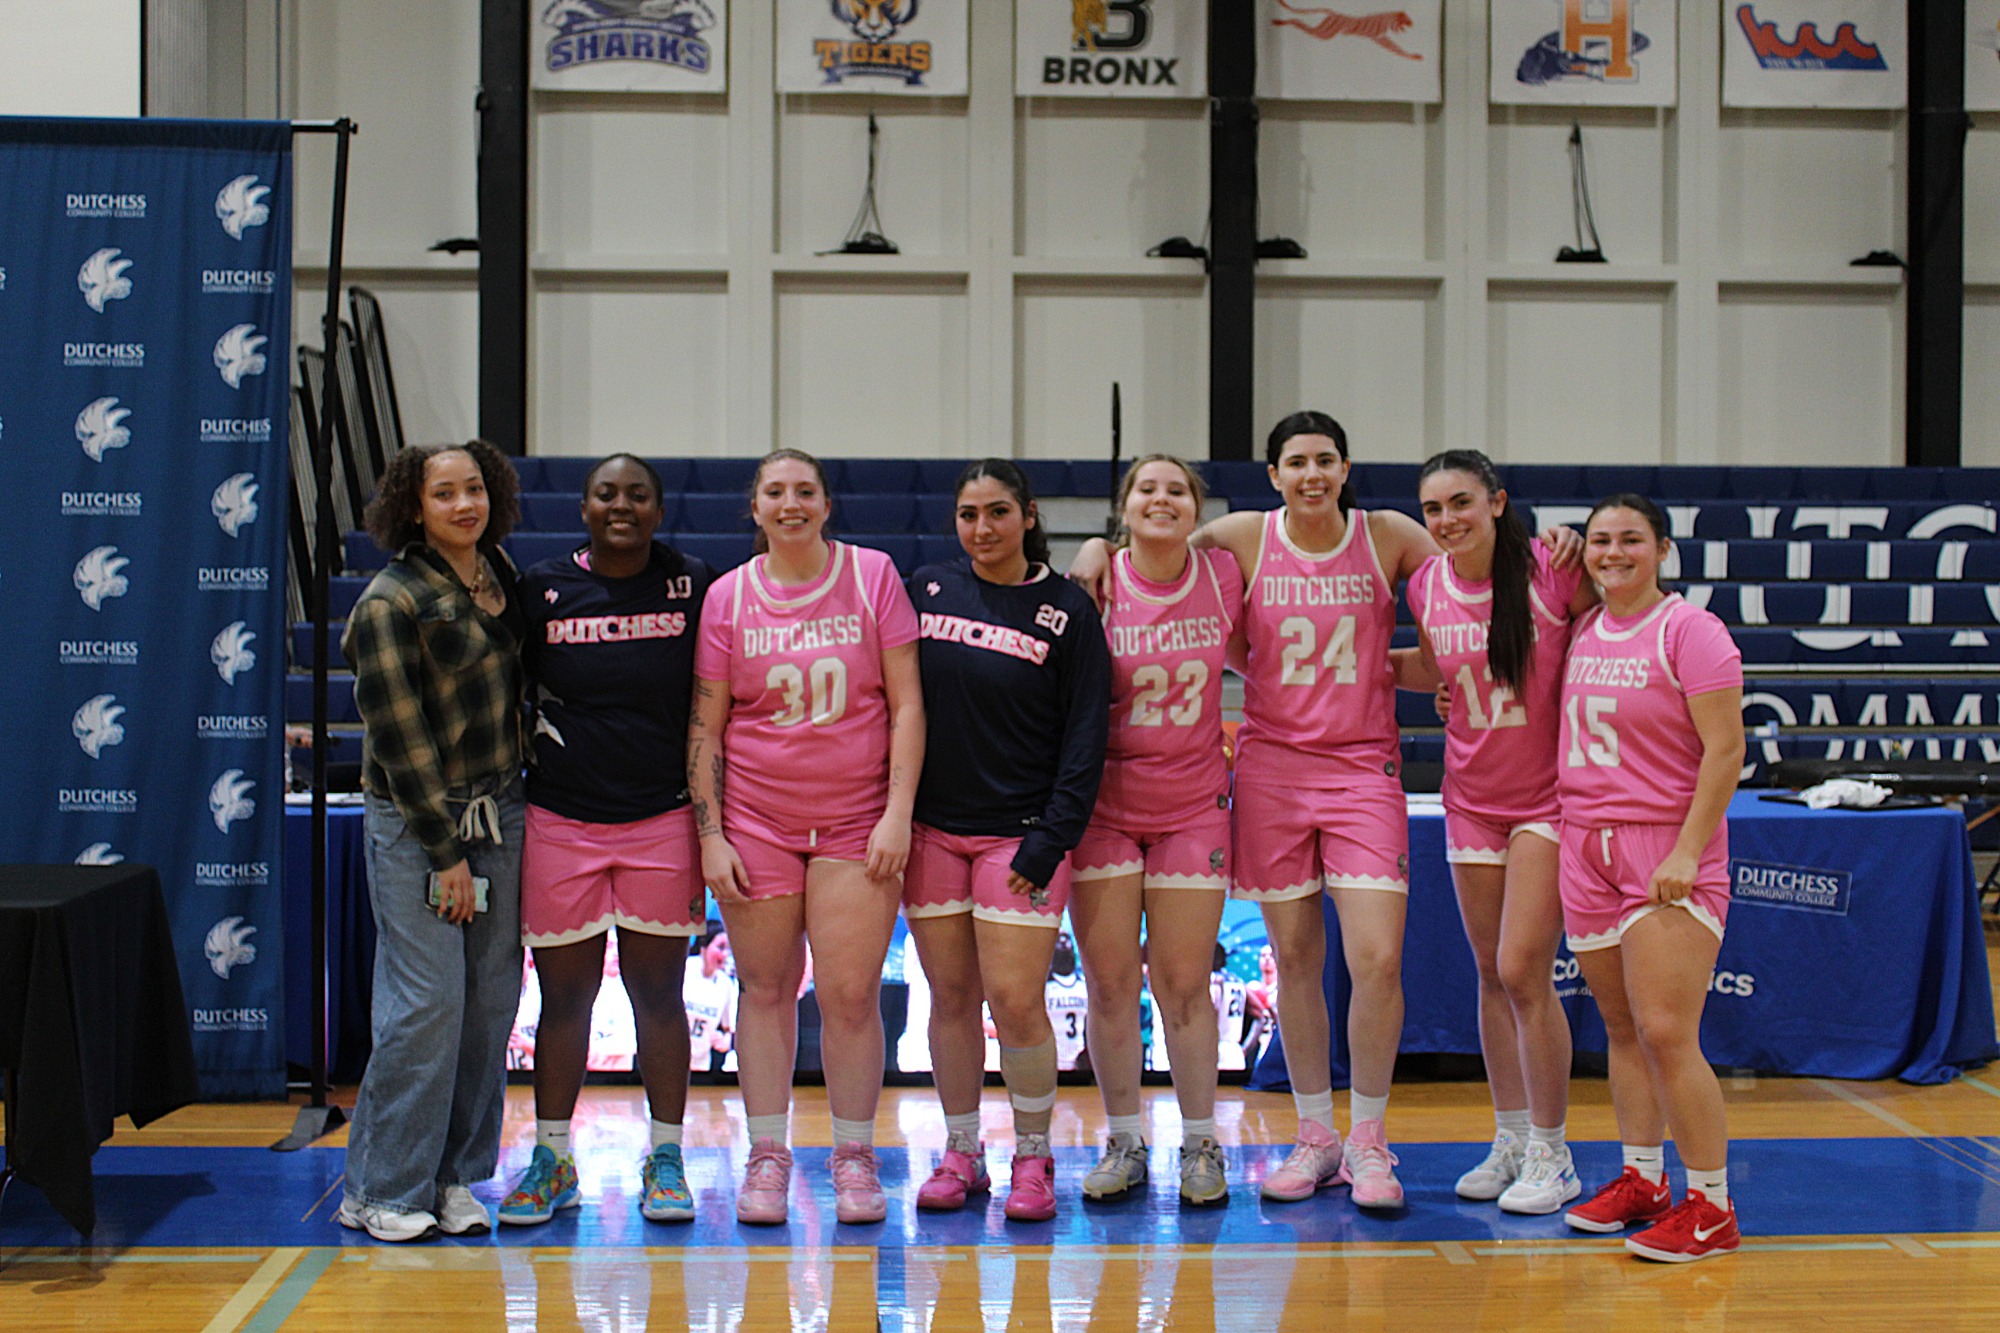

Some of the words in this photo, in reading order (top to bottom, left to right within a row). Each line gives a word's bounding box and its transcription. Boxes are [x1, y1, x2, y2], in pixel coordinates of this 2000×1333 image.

[550, 32, 709, 71] SHARKS
[814, 39, 932, 72] TIGERS
[1042, 57, 1179, 86] BRONX
[66, 194, 147, 209] DUTCHESS
[64, 343, 145, 358] DUTCHESS
[61, 492, 142, 507] DUTCHESS
[667, 575, 692, 599] 10
[1262, 574, 1375, 606] DUTCHESS
[546, 611, 687, 644] DUTCHESS
[1035, 603, 1069, 636] 20
[60, 641, 138, 656] DUTCHESS
[744, 614, 863, 658] DUTCHESS
[920, 612, 1051, 666] DUTCHESS
[1112, 616, 1221, 657] DUTCHESS
[1280, 614, 1358, 686] 24
[766, 657, 848, 727] 30
[1129, 659, 1210, 727] 23
[1455, 663, 1528, 730] 12
[197, 716, 268, 730] DUTCHESS
[1566, 694, 1621, 768] 15
[59, 789, 137, 804] DUTCHESS
[195, 863, 269, 878] DUTCHESS
[1738, 866, 1839, 896] DUTCHESS
[1736, 886, 1794, 902] COMMUNITY
[1795, 892, 1837, 907] COLLEGE
[193, 1008, 268, 1024] DUTCHESS
